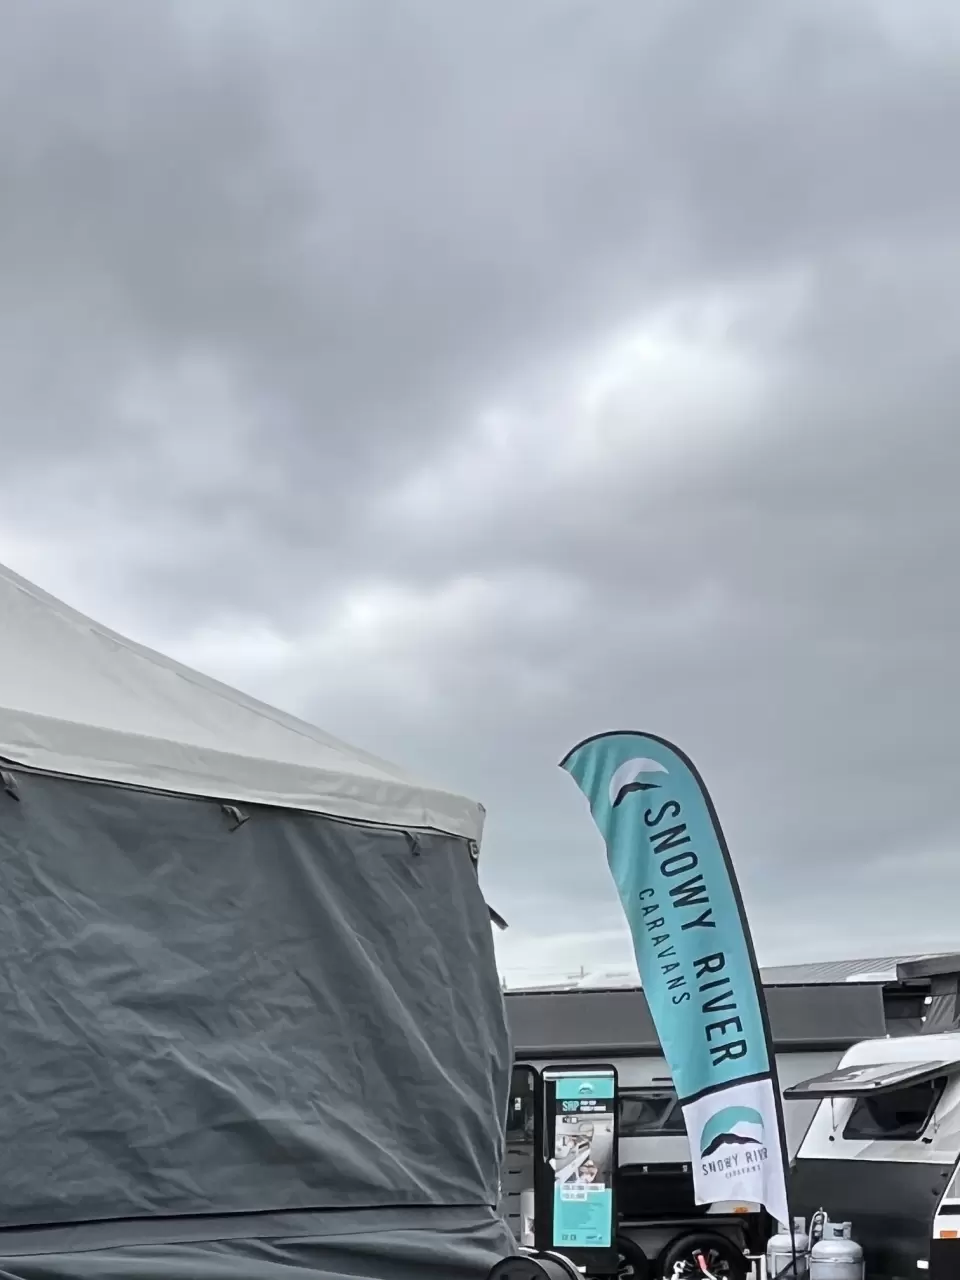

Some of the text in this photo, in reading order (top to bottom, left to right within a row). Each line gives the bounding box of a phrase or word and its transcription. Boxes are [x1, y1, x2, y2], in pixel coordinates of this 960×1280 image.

[638, 888, 690, 1005] CARAVANS
[644, 800, 747, 1067] SNOWY RIVER
[702, 1153, 739, 1176] SNOWY
